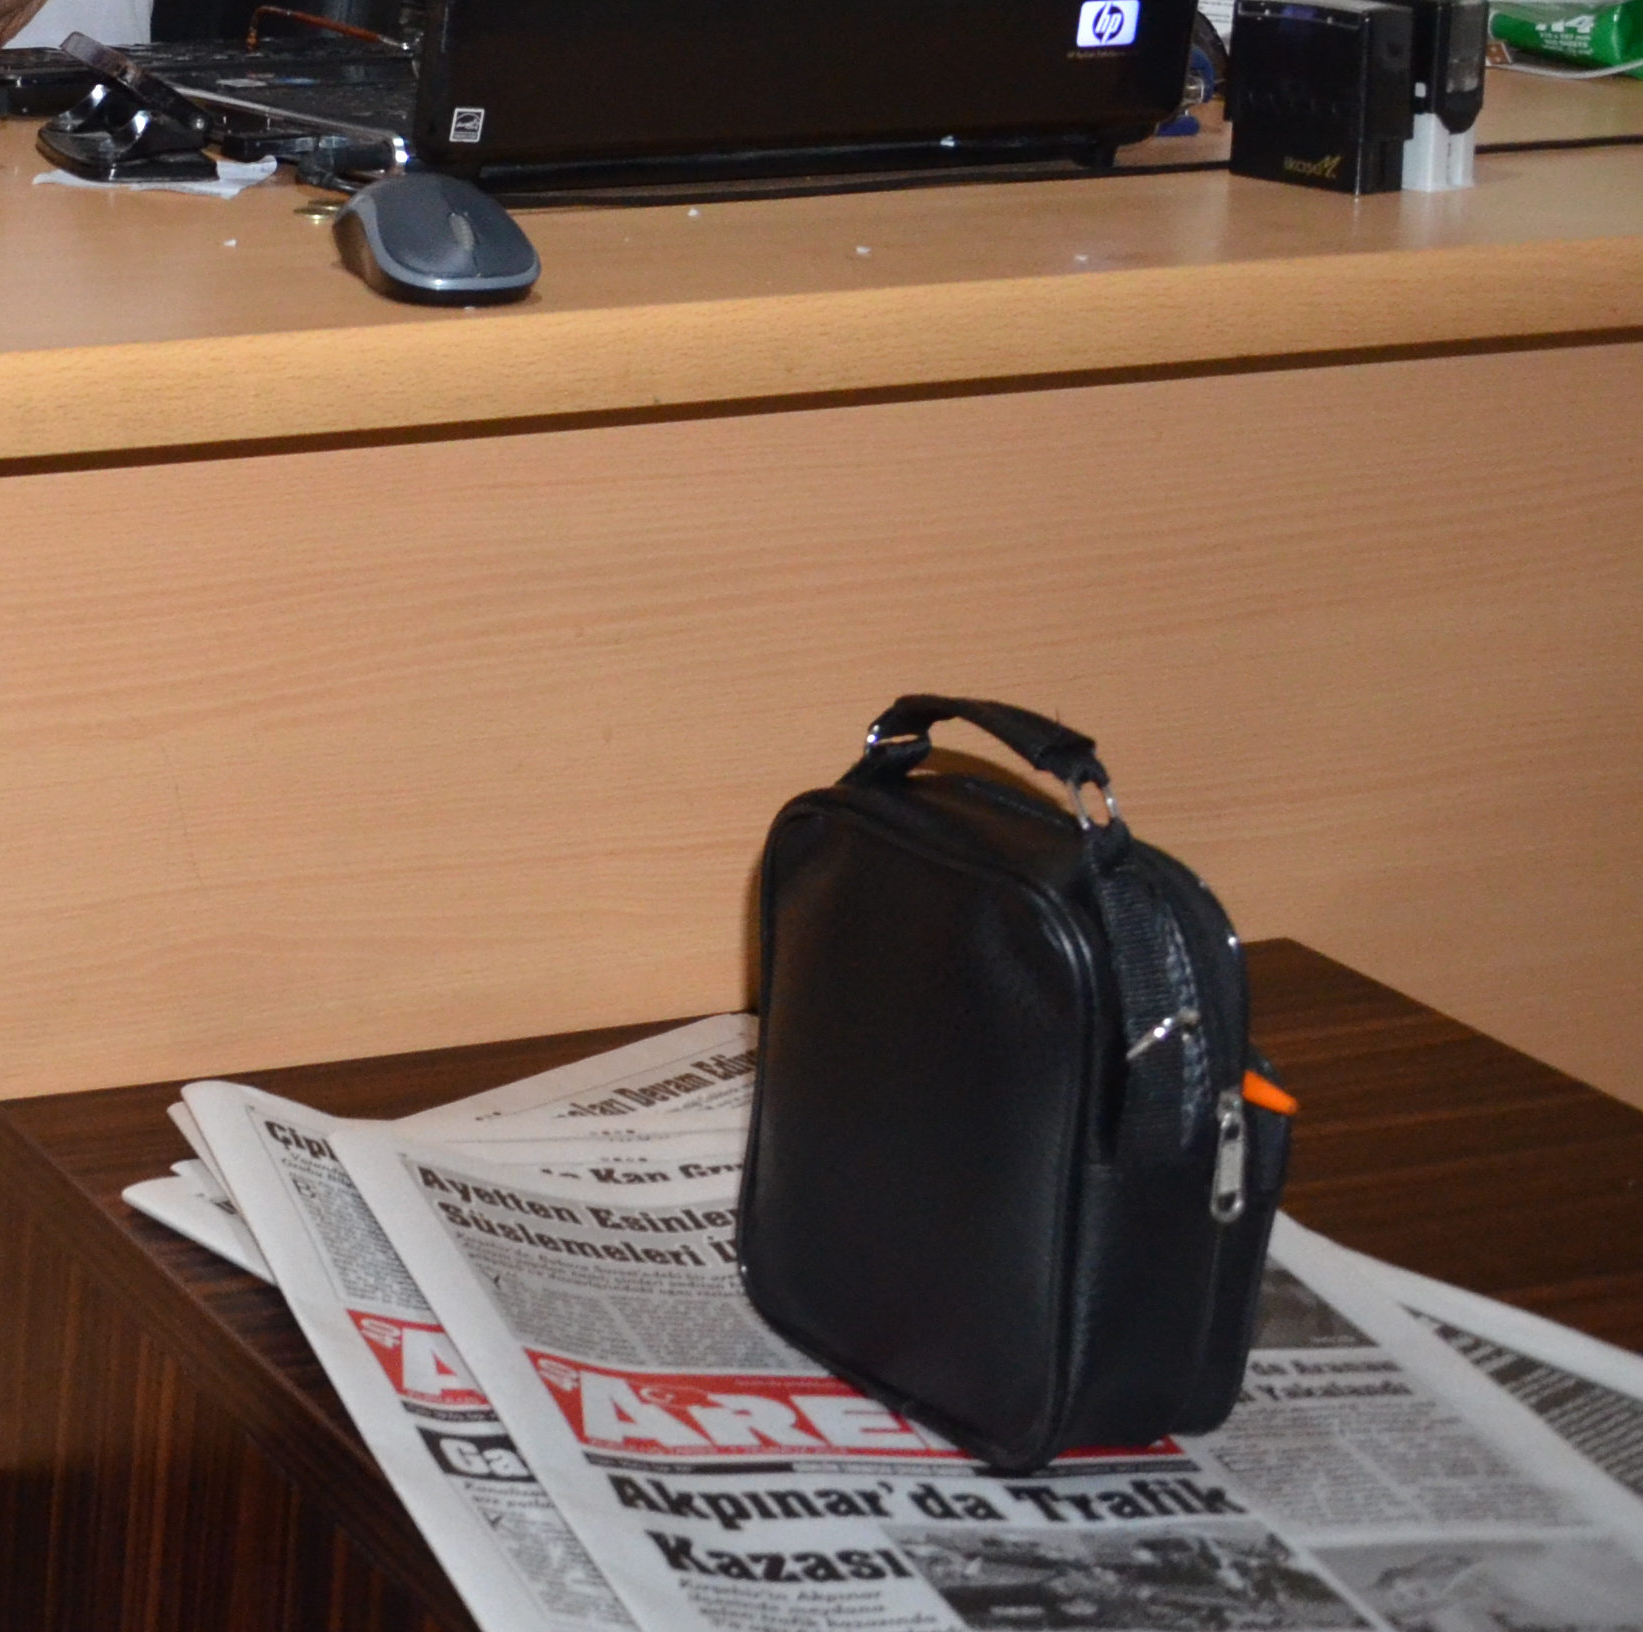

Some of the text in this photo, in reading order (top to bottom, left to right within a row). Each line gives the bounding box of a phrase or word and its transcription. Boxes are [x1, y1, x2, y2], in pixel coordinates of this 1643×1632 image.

[613, 1073, 716, 1107] Devam
[418, 1166, 737, 1233] Ayetten Esinle
[588, 1167, 672, 1185] Kan
[438, 1200, 706, 1267] Süslemeleri
[1004, 1474, 1249, 1523] Trafik
[647, 1529, 914, 1583] Kazası
